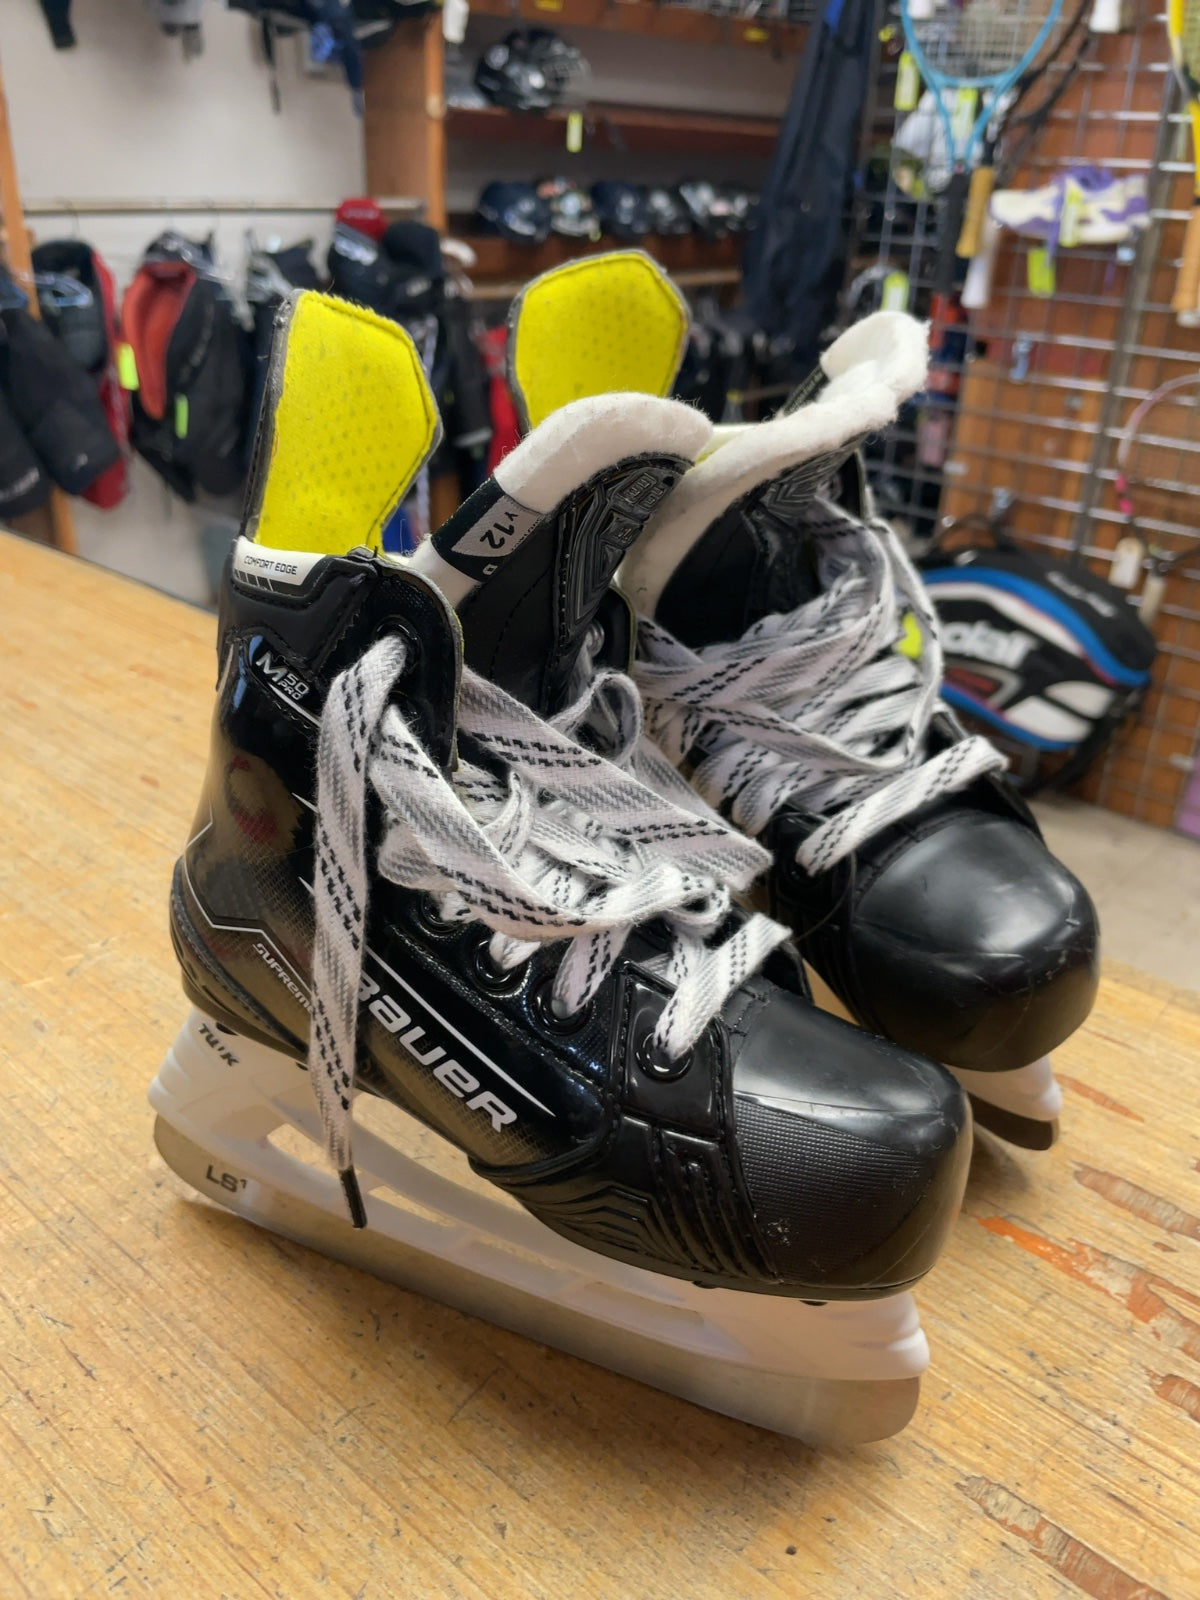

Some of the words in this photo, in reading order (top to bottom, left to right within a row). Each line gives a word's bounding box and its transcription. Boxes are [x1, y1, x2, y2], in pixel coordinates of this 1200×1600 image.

[243, 555, 275, 570] COMFORT
[274, 562, 298, 575] EDGE
[277, 680, 302, 700] PRO
